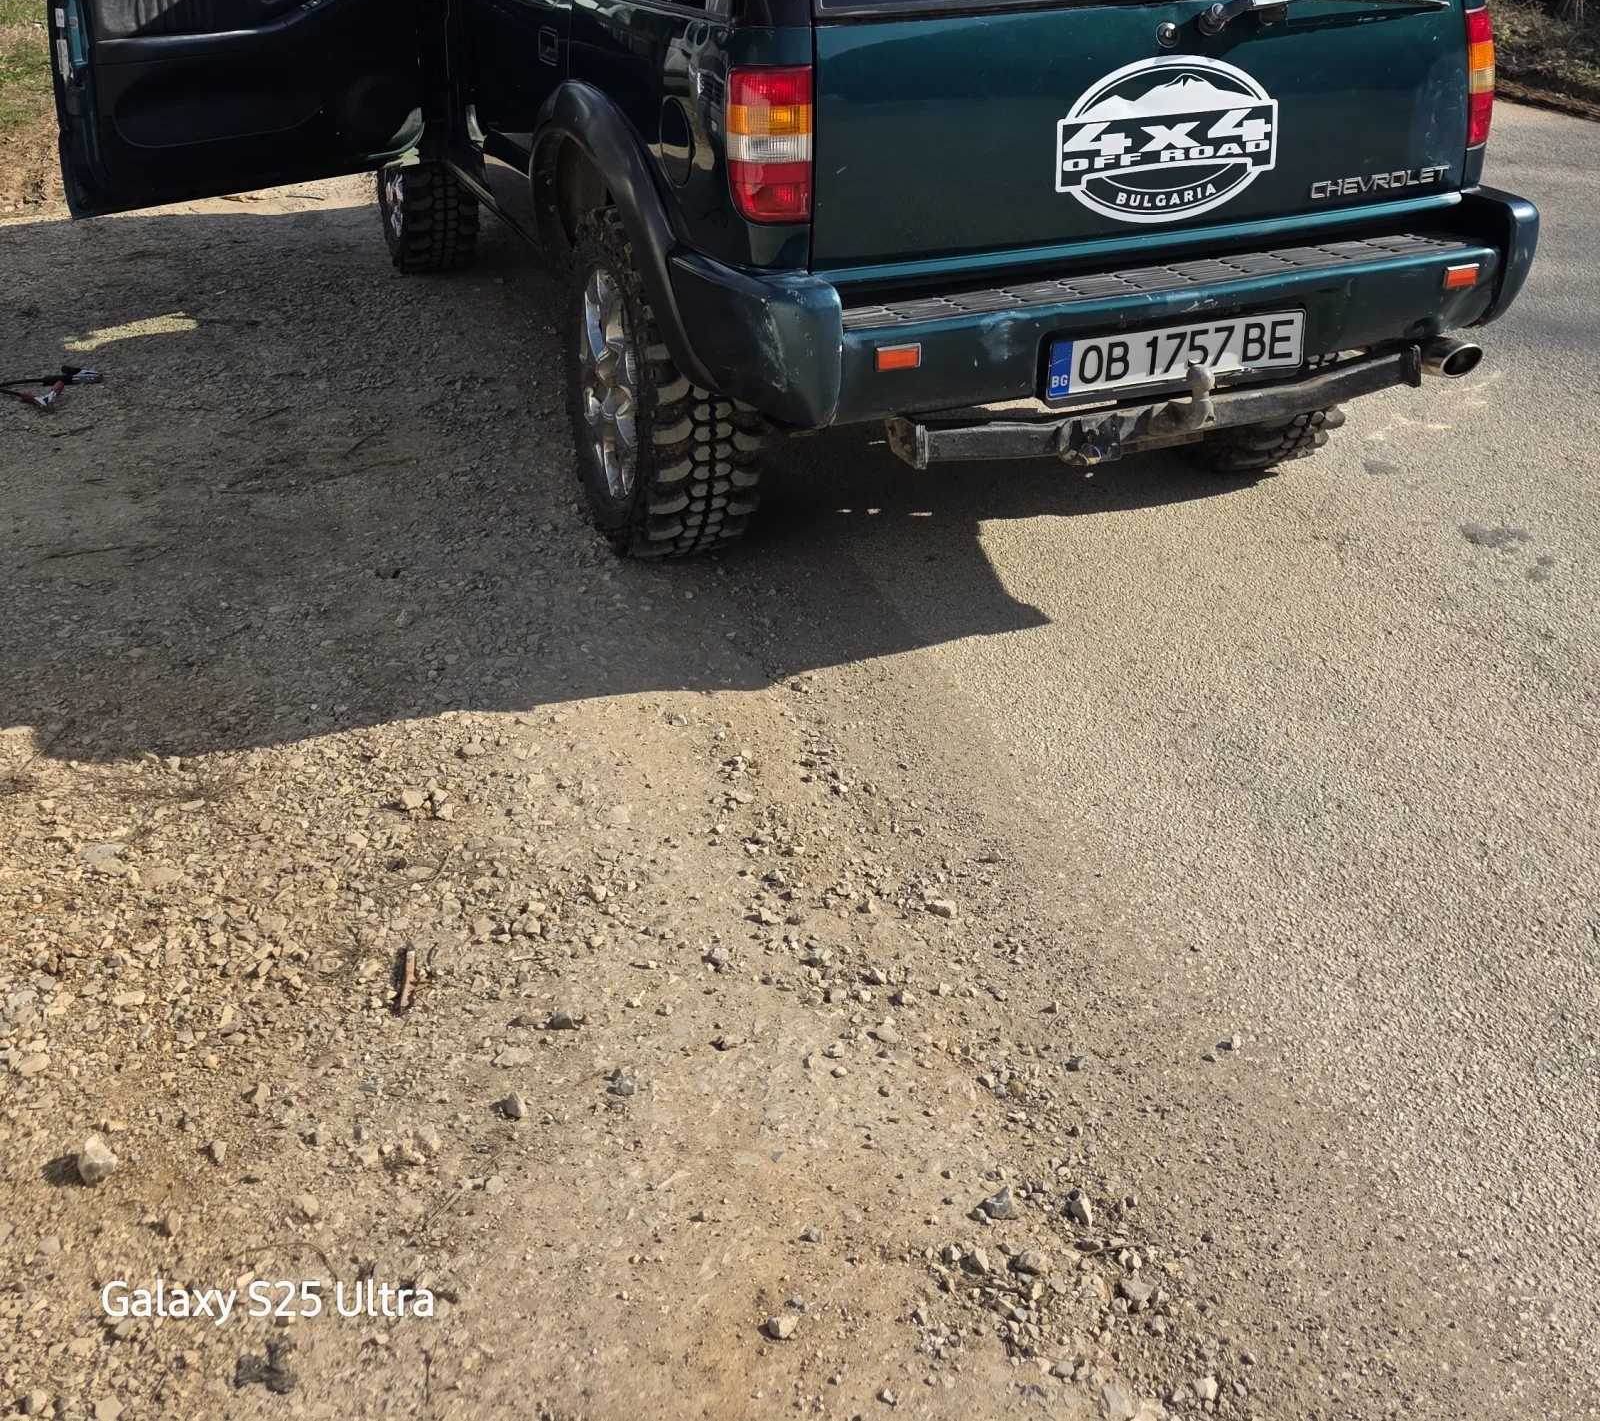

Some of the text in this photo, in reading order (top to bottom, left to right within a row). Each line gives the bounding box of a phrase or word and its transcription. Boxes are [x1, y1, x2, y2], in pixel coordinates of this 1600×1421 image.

[1062, 139, 1270, 173] OFF ROAD
[1115, 183, 1217, 207] BULGARIA
[1310, 165, 1451, 199] CHEVROLET
[1051, 375, 1068, 388] BG
